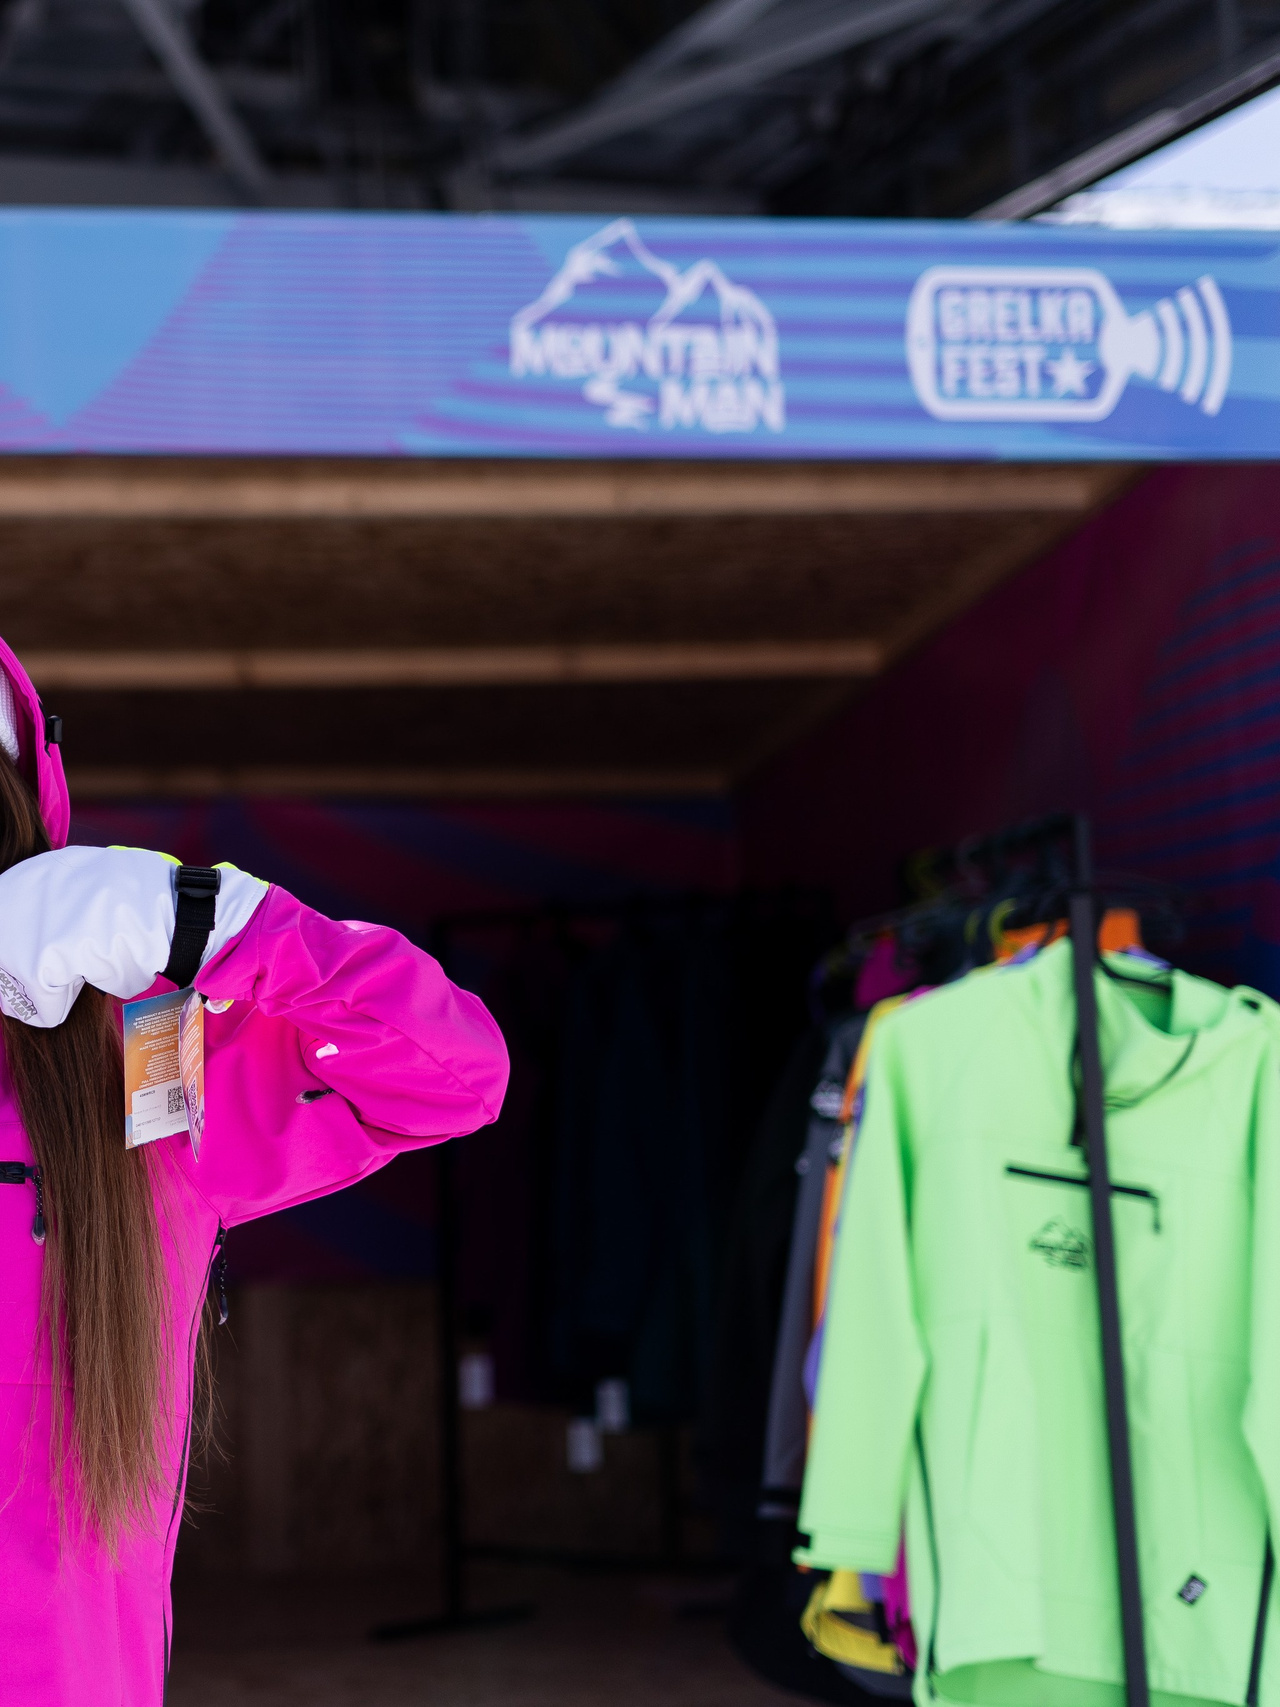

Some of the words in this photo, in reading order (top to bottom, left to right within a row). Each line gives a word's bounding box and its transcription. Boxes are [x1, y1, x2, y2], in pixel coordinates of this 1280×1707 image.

[939, 289, 1094, 341] GRELKA
[509, 320, 780, 380] MOUNTAIN
[941, 345, 1046, 398] FEST
[659, 377, 786, 432] MAN
[8, 997, 32, 1021] MAN
